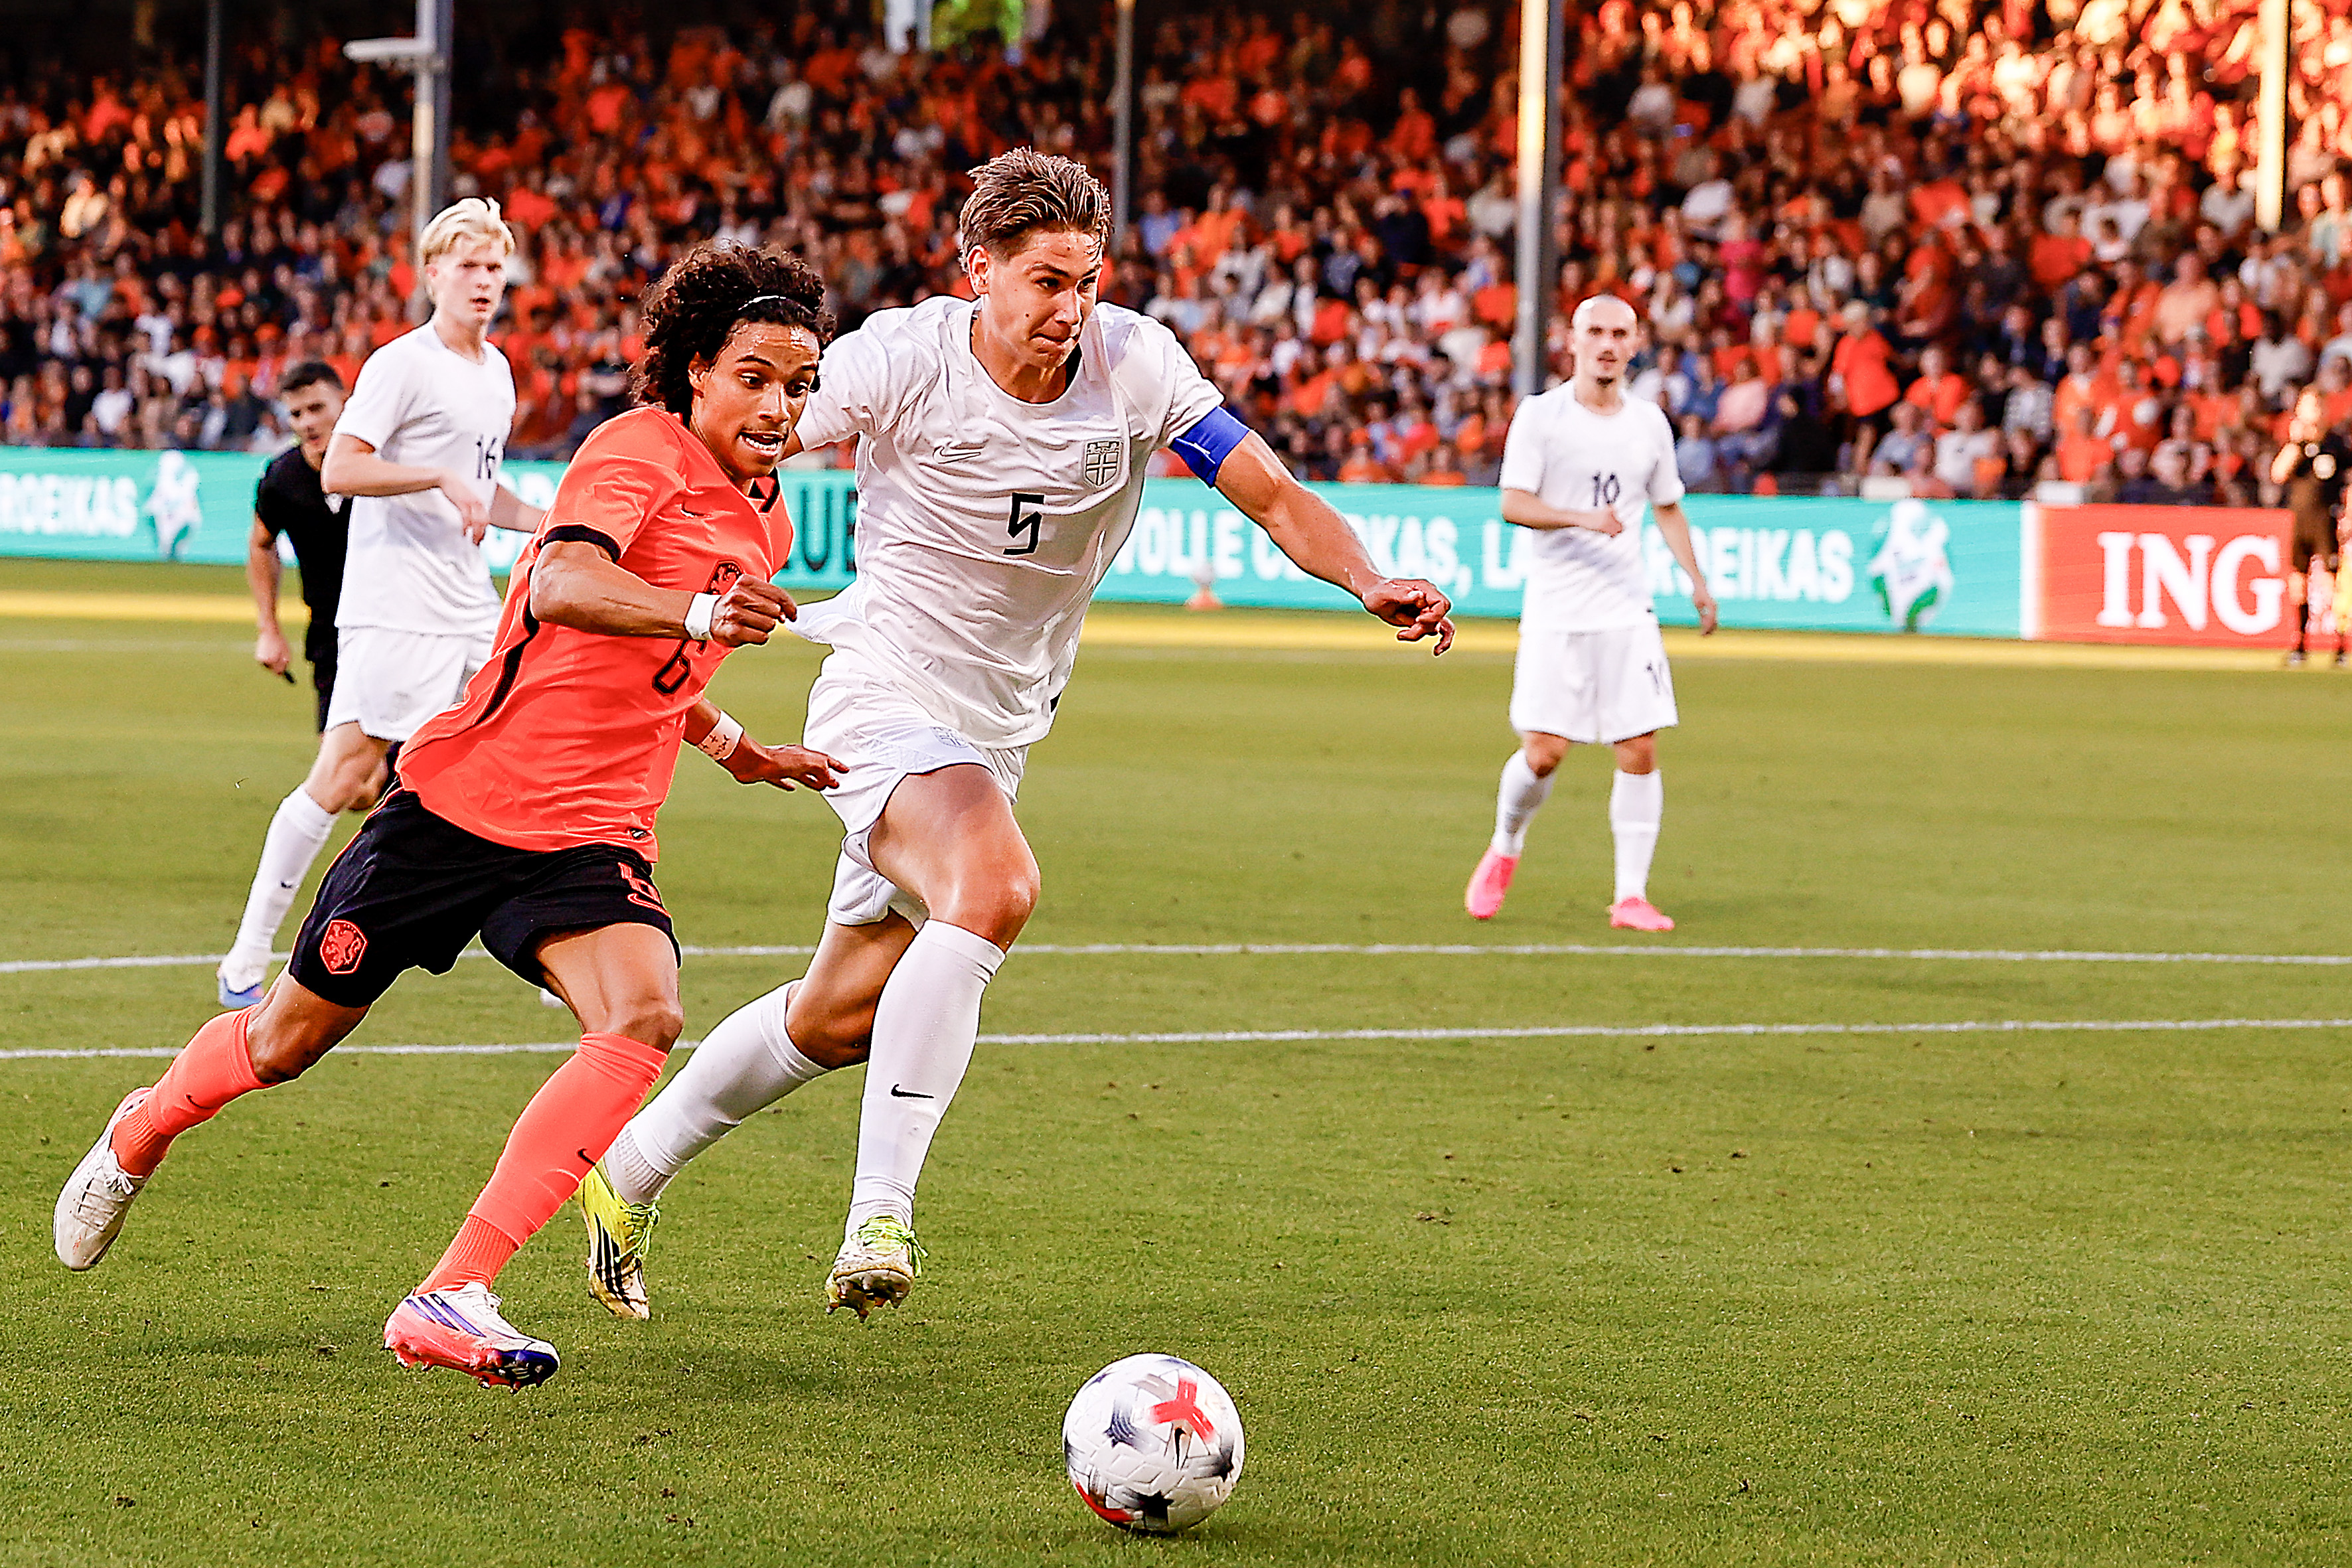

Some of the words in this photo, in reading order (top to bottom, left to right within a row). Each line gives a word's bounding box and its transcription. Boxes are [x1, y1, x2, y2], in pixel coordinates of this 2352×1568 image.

[476, 434, 498, 480] 16
[1593, 471, 1620, 507] 10
[1002, 492, 1045, 556] 5
[2096, 530, 2288, 635] ING
